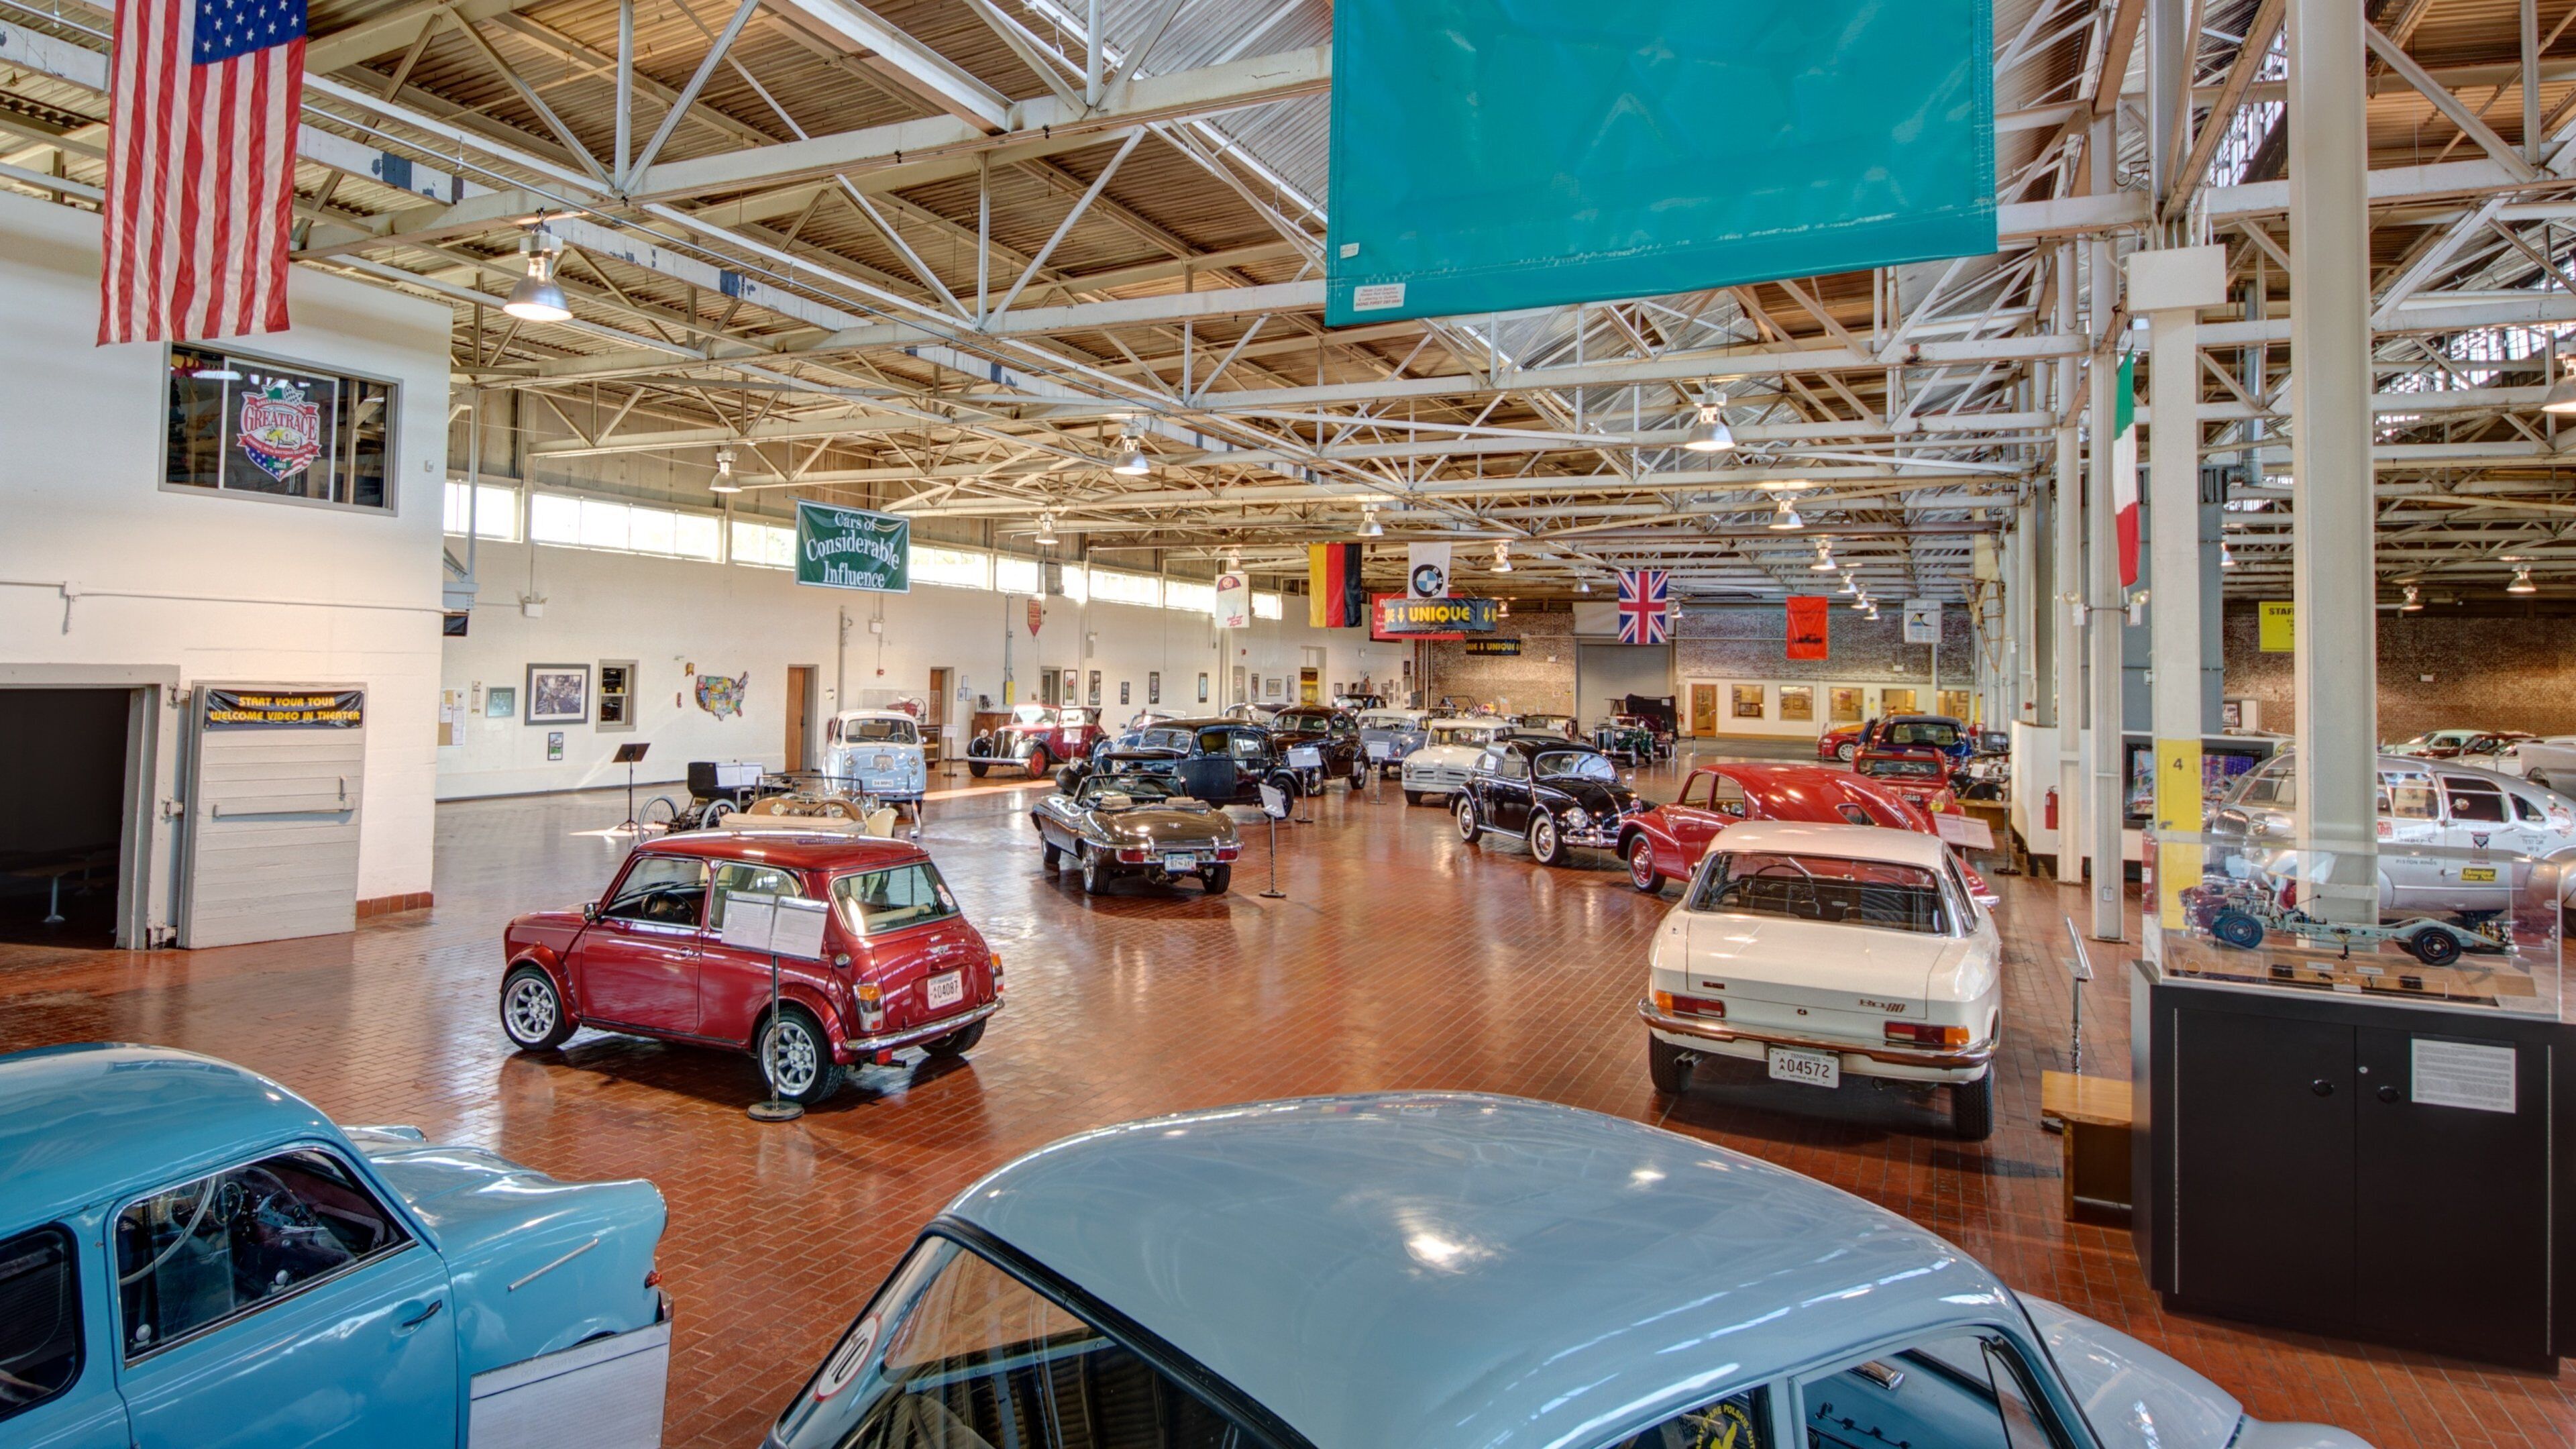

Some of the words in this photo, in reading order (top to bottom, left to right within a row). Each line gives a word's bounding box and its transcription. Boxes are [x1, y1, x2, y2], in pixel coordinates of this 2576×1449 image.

[244, 405, 317, 441] GREATRACE
[835, 511, 862, 530] Cars
[864, 518, 878, 531] of
[806, 529, 900, 570] Considerable
[822, 560, 885, 588] Influence
[1409, 606, 1470, 623] UNIQUE
[1487, 642, 1515, 651] UNIQUE
[238, 696, 272, 706] START
[275, 697, 304, 706] YOUR
[307, 696, 335, 706] TOUR
[210, 710, 264, 721] WELCOME
[267, 710, 300, 721] VIDEO
[303, 711, 313, 721] IN
[317, 710, 360, 720] THEATER
[2173, 758, 2183, 771] 4
[1787, 1059, 1830, 1079] 04572
